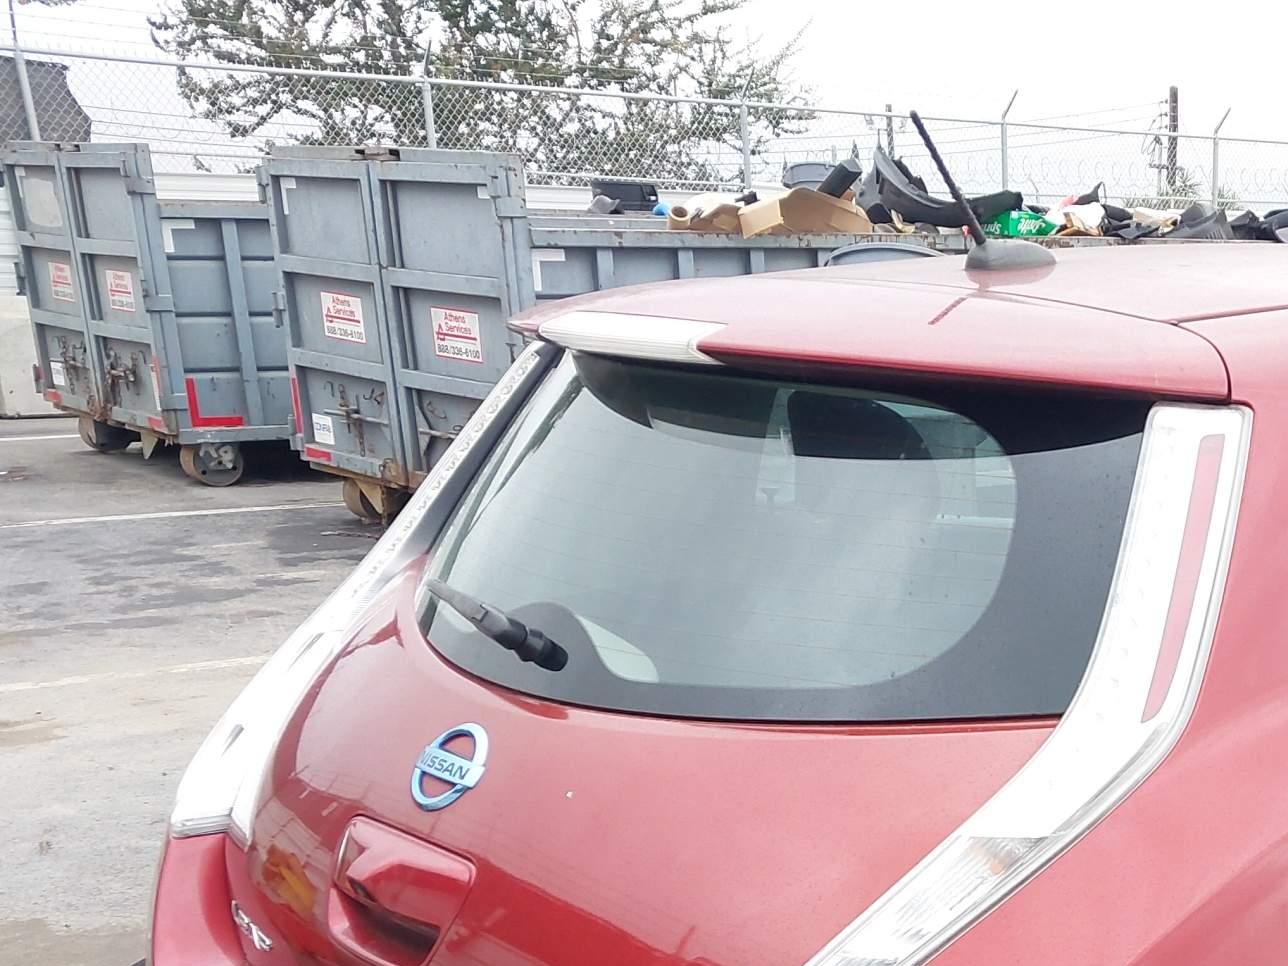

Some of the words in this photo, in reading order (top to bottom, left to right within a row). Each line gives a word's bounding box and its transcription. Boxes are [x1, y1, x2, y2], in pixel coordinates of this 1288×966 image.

[444, 312, 466, 324] Athens
[445, 322, 472, 335] Services
[420, 750, 471, 781] NISSAN
